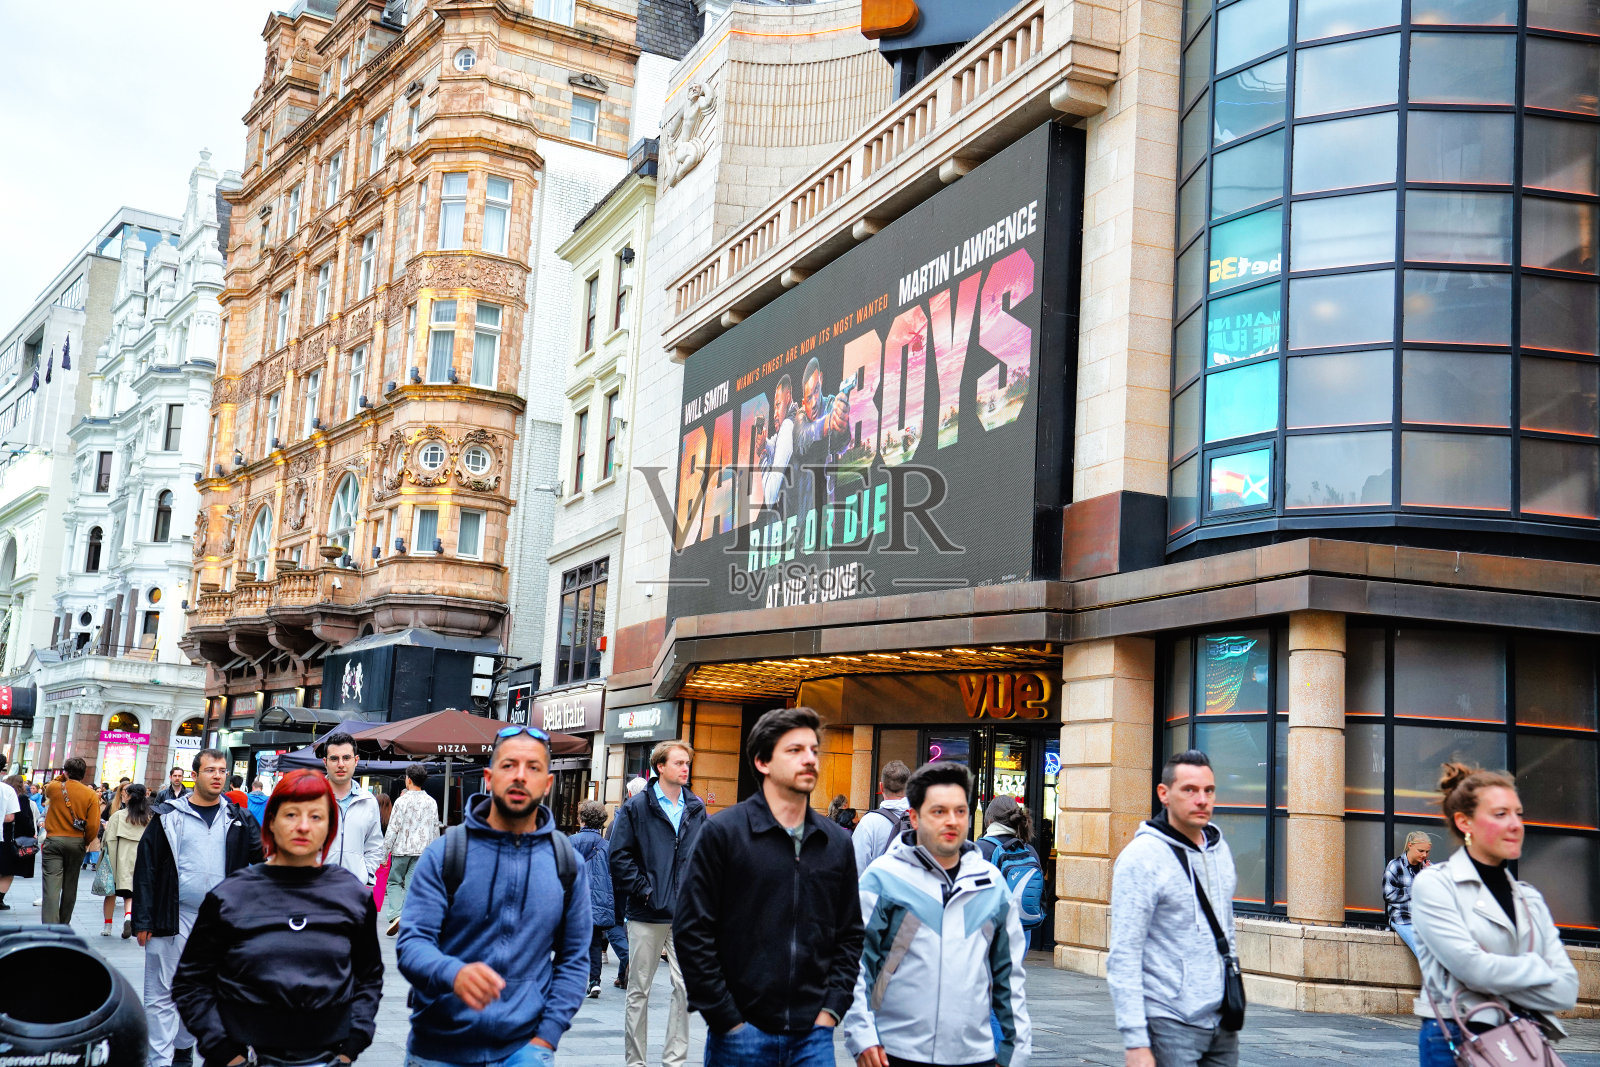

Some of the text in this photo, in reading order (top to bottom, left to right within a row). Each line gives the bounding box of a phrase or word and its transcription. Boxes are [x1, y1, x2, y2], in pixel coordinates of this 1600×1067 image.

[898, 199, 1038, 307] MARTIN LAWRENCE
[736, 293, 889, 392] MIAMI'S FINEST ARE NOW ITS MOST WANTED
[674, 247, 1036, 553] BAD BOYS
[684, 380, 730, 426] WILL SMITH
[747, 482, 888, 573] RIDE OR DIE
[765, 582, 781, 609] AT
[783, 575, 807, 607] VUE
[820, 561, 858, 602] JUNE
[542, 703, 562, 731] Bella
[563, 699, 586, 729] Italia
[175, 737, 201, 748] SOUV
[437, 744, 468, 753] PIZZA
[481, 744, 493, 753] PA
[0, 1051, 81, 1067] general litter
